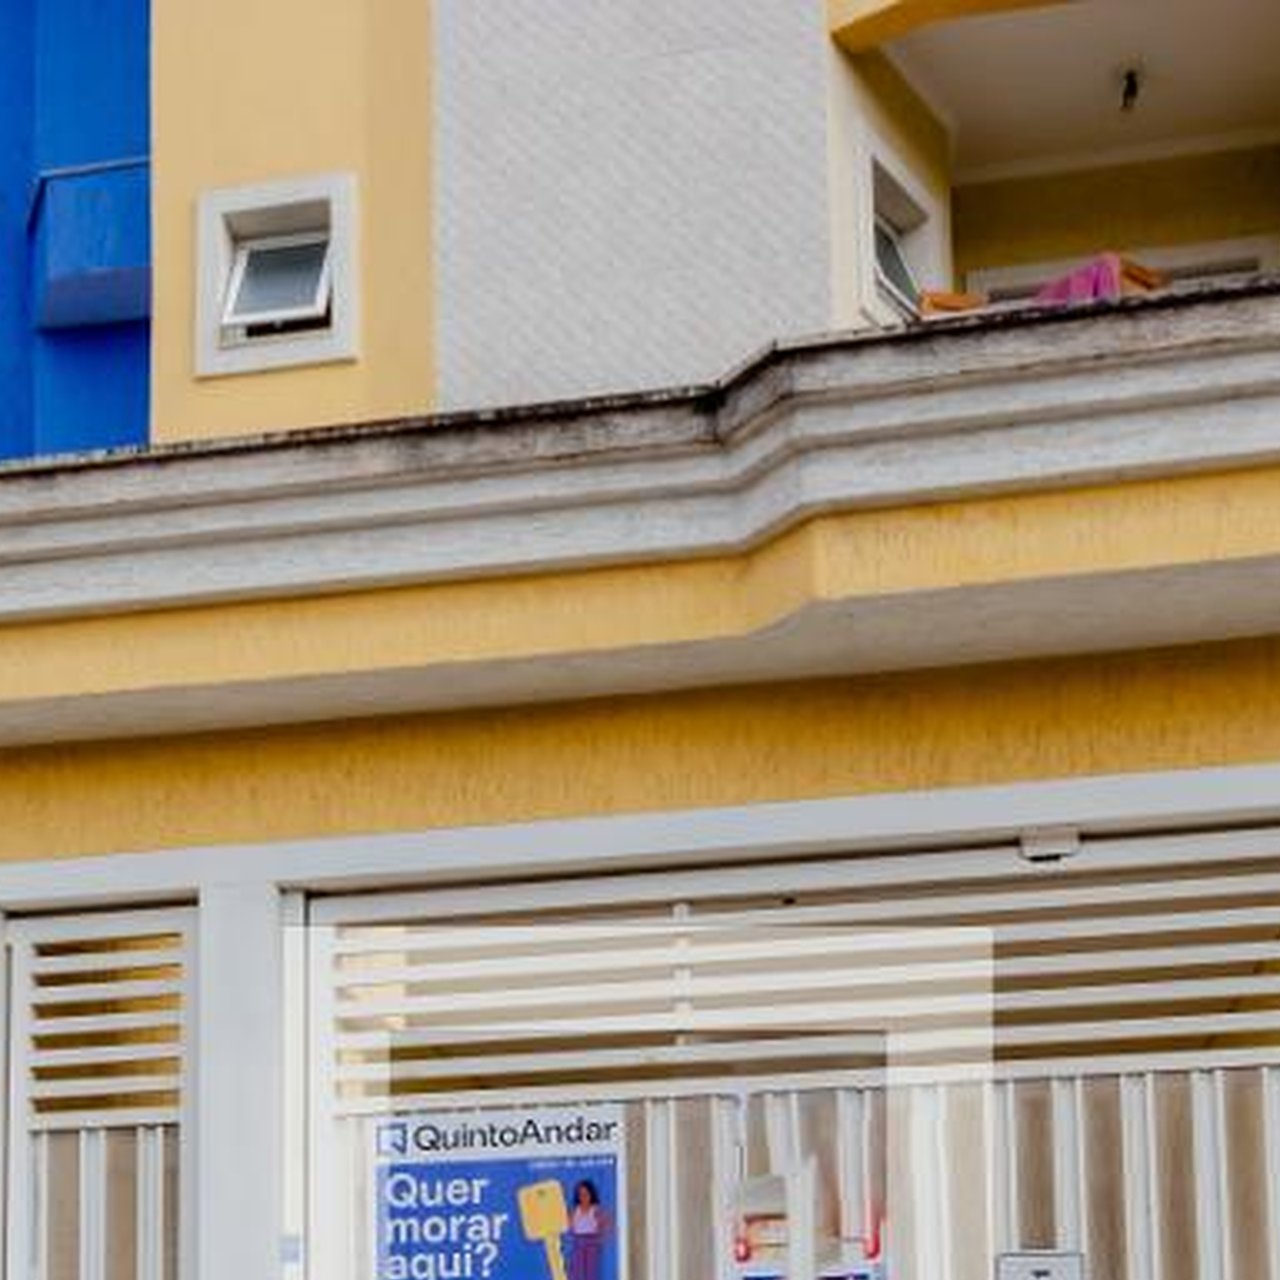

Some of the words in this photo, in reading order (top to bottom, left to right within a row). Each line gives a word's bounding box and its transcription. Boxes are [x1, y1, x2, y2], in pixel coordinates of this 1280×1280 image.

[413, 1117, 617, 1152] QuintoAndar
[385, 1172, 489, 1209] Quer
[387, 1213, 508, 1244] morar
